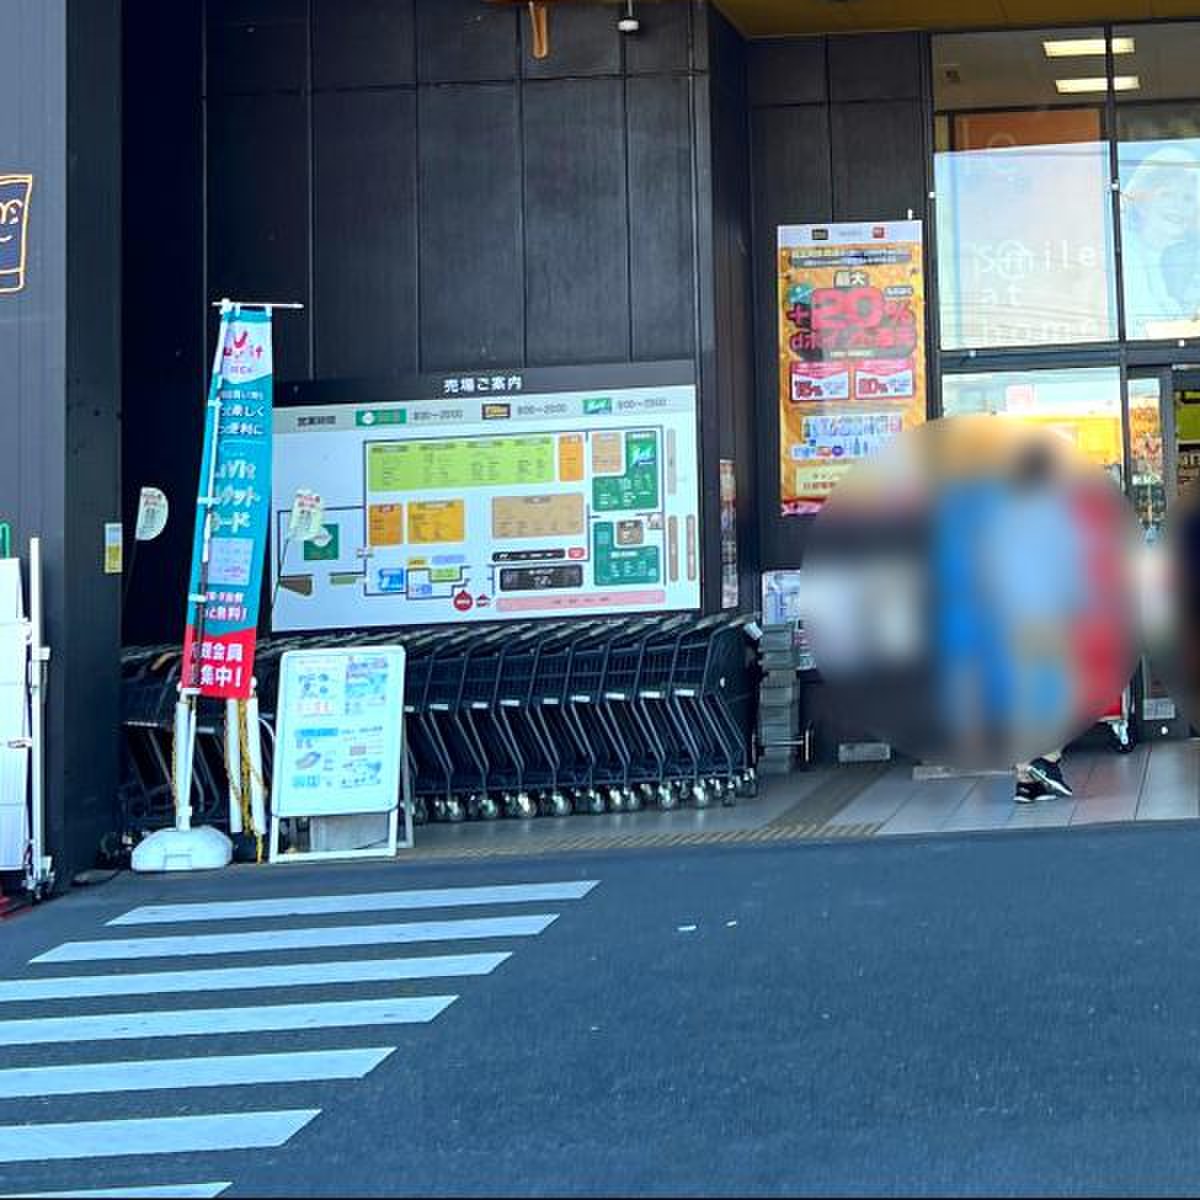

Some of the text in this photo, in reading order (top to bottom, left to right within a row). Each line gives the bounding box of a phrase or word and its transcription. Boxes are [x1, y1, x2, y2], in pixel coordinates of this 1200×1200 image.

[443, 375, 523, 394] 売場ご案内
